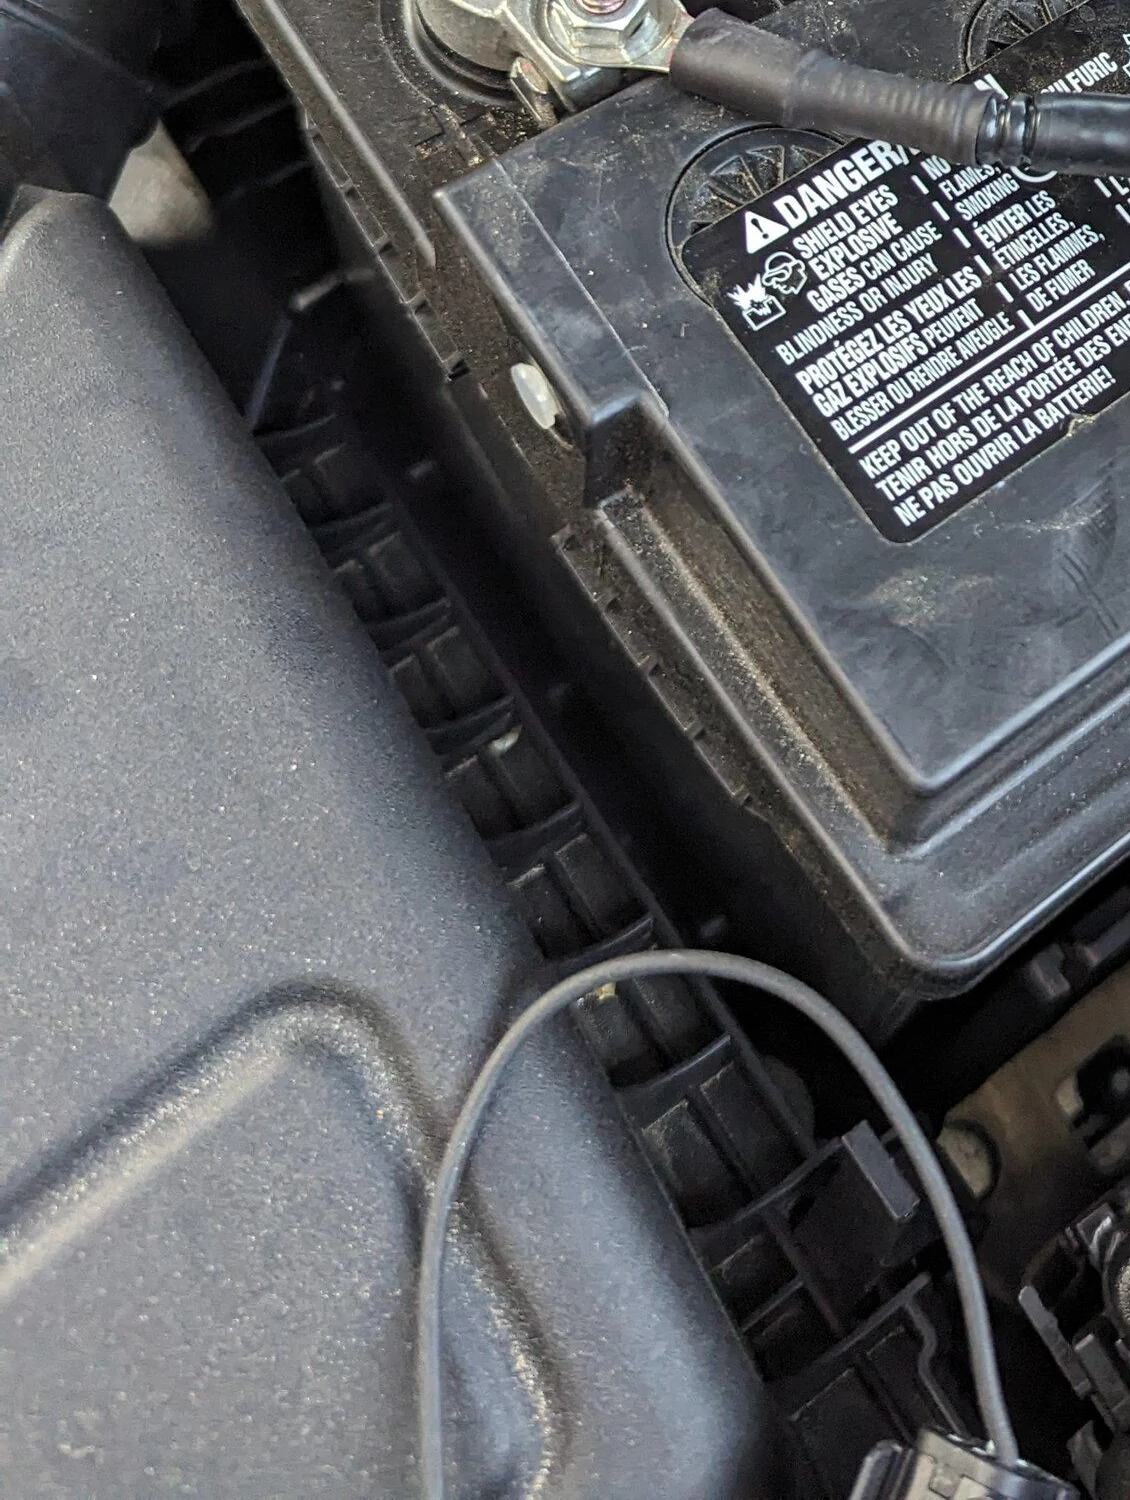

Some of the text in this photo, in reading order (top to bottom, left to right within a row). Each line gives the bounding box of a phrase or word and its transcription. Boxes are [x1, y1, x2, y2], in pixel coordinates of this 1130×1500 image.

[920, 154, 951, 180] NO
[954, 172, 1019, 220] SMOKING
[792, 184, 898, 259] SHIELD EYES
[806, 211, 902, 280] EXPLOSIVE
[972, 189, 1055, 249] ÉVITER LES
[991, 212, 1075, 270] ÉTINCELLES,
[1008, 224, 1105, 290] LES FLAMMES,
[806, 220, 942, 312] GASES CAN CAUSE
[1025, 258, 1095, 312] DE FUMER
[775, 252, 938, 365] BLINDNESS OR INJURY
[794, 265, 982, 395] PROTÉGEZ LES YEUX LES
[812, 297, 983, 417] GAZ EXPLOSIFS PEUVENT
[830, 311, 1015, 440] BLESSER OU RENDRE AVEUGLE
[858, 439, 901, 478] KEEP
[899, 416, 936, 451] OUT
[931, 401, 957, 429] OF
[951, 382, 990, 414] THE
[981, 350, 1038, 395] REACH
[1031, 336, 1055, 362] OF
[1051, 290, 1130, 348] CHILDREN.
[874, 456, 932, 501] TENIR
[925, 425, 977, 469] HORS
[970, 408, 1001, 437] DE
[993, 395, 1024, 422] LA
[1015, 354, 1081, 407] PORTÉE
[1073, 334, 1111, 367] DES
[893, 365, 1115, 526] NE PAS OUVRIR LA BATTERIE!
